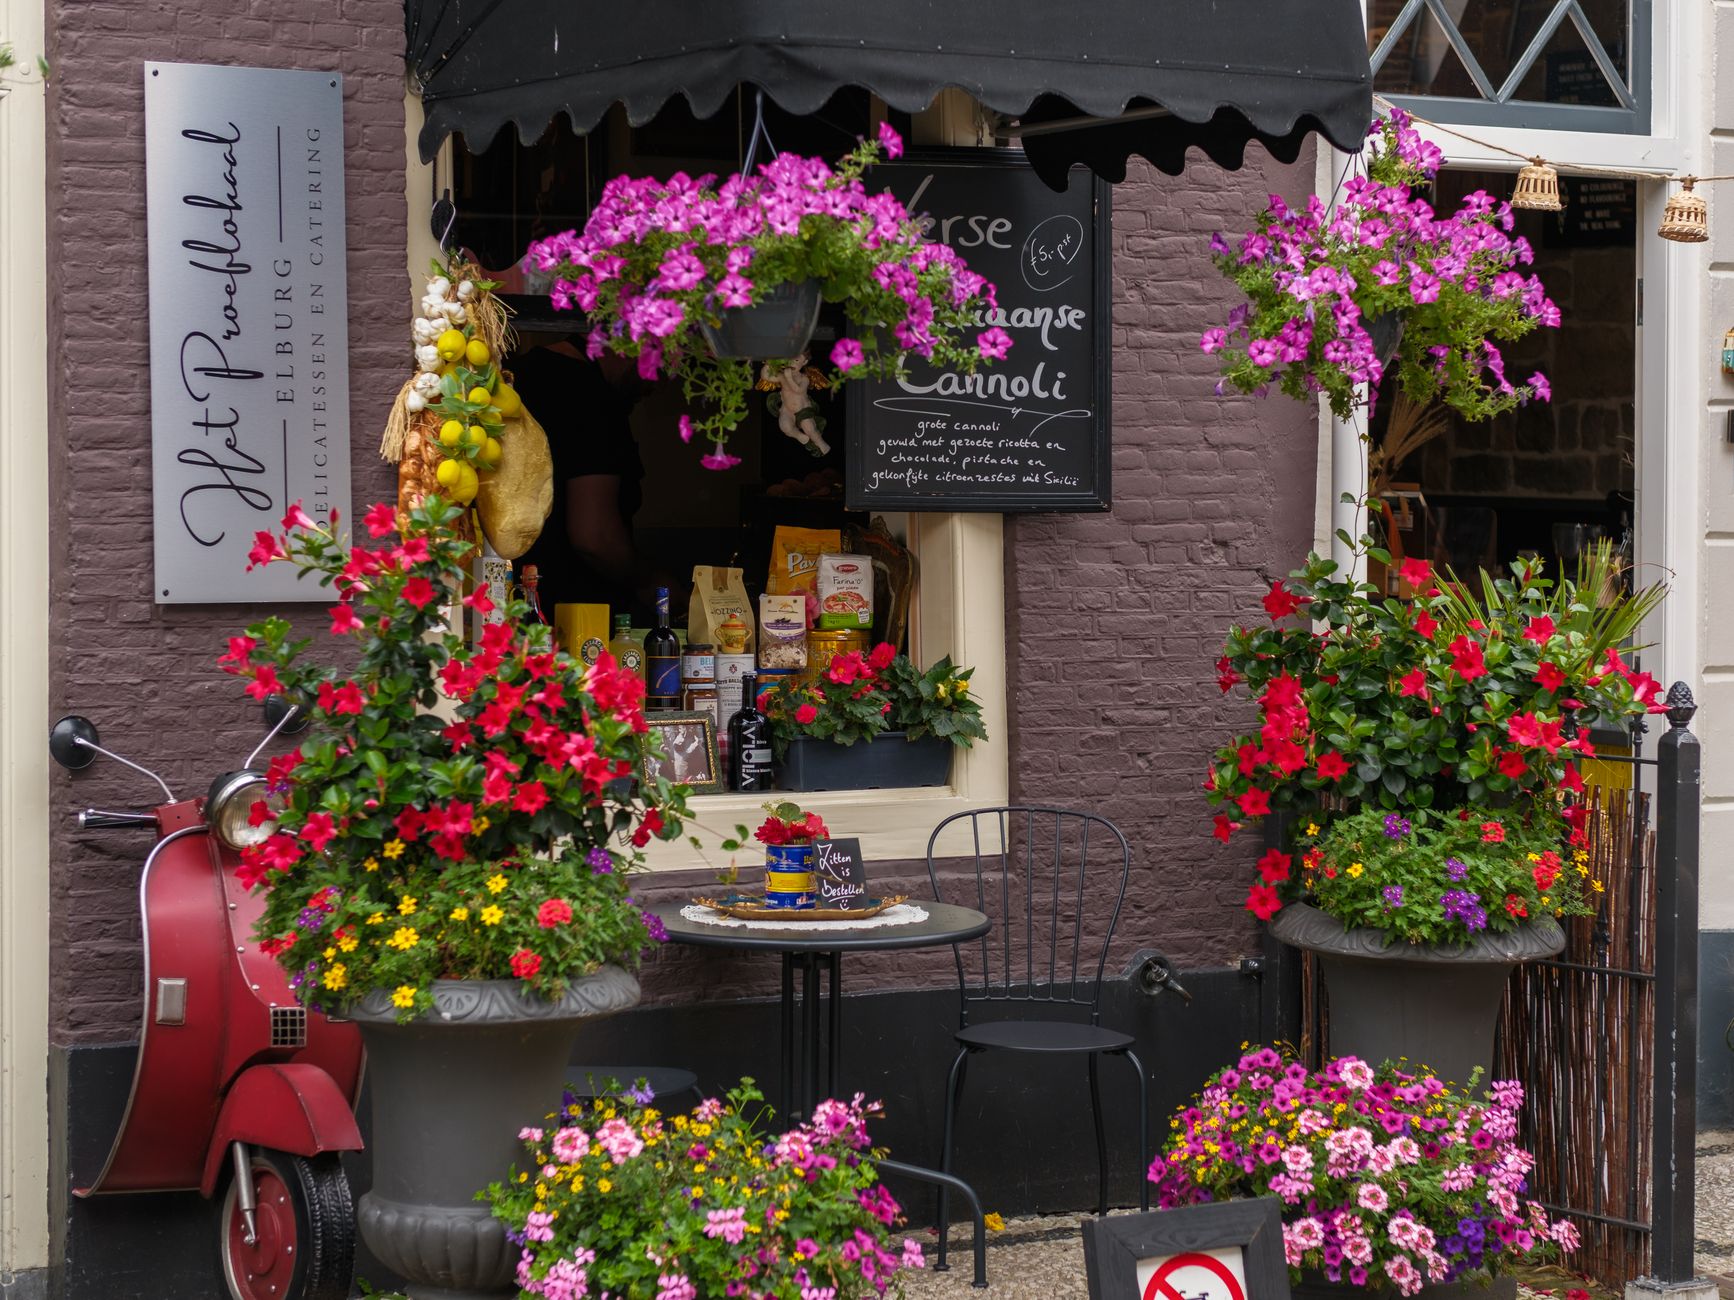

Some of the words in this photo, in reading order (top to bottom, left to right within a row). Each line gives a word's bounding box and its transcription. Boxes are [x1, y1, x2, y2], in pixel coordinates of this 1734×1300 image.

[306, 126, 323, 266] CATERING
[180, 122, 264, 403] Proeflokaal
[309, 282, 324, 315] EN
[273, 258, 295, 404] ELBURG
[895, 351, 1067, 401] Cannoli
[914, 420, 947, 438] grote
[954, 421, 1001, 431] cannoli
[876, 438, 918, 455] gevuld
[922, 438, 945, 447] met
[949, 438, 994, 455] gezoete
[998, 438, 1040, 448] ricotta
[1046, 442, 1066, 451] en
[962, 455, 1020, 470] pistache
[1027, 459, 1046, 467] en
[177, 407, 273, 547] Het
[868, 468, 929, 489] gekonfijte
[787, 552, 819, 573] Pav
[832, 576, 855, 585] Farina
[742, 726, 756, 787] VIOLA
[816, 844, 852, 881] Zitten
[841, 866, 850, 876] is
